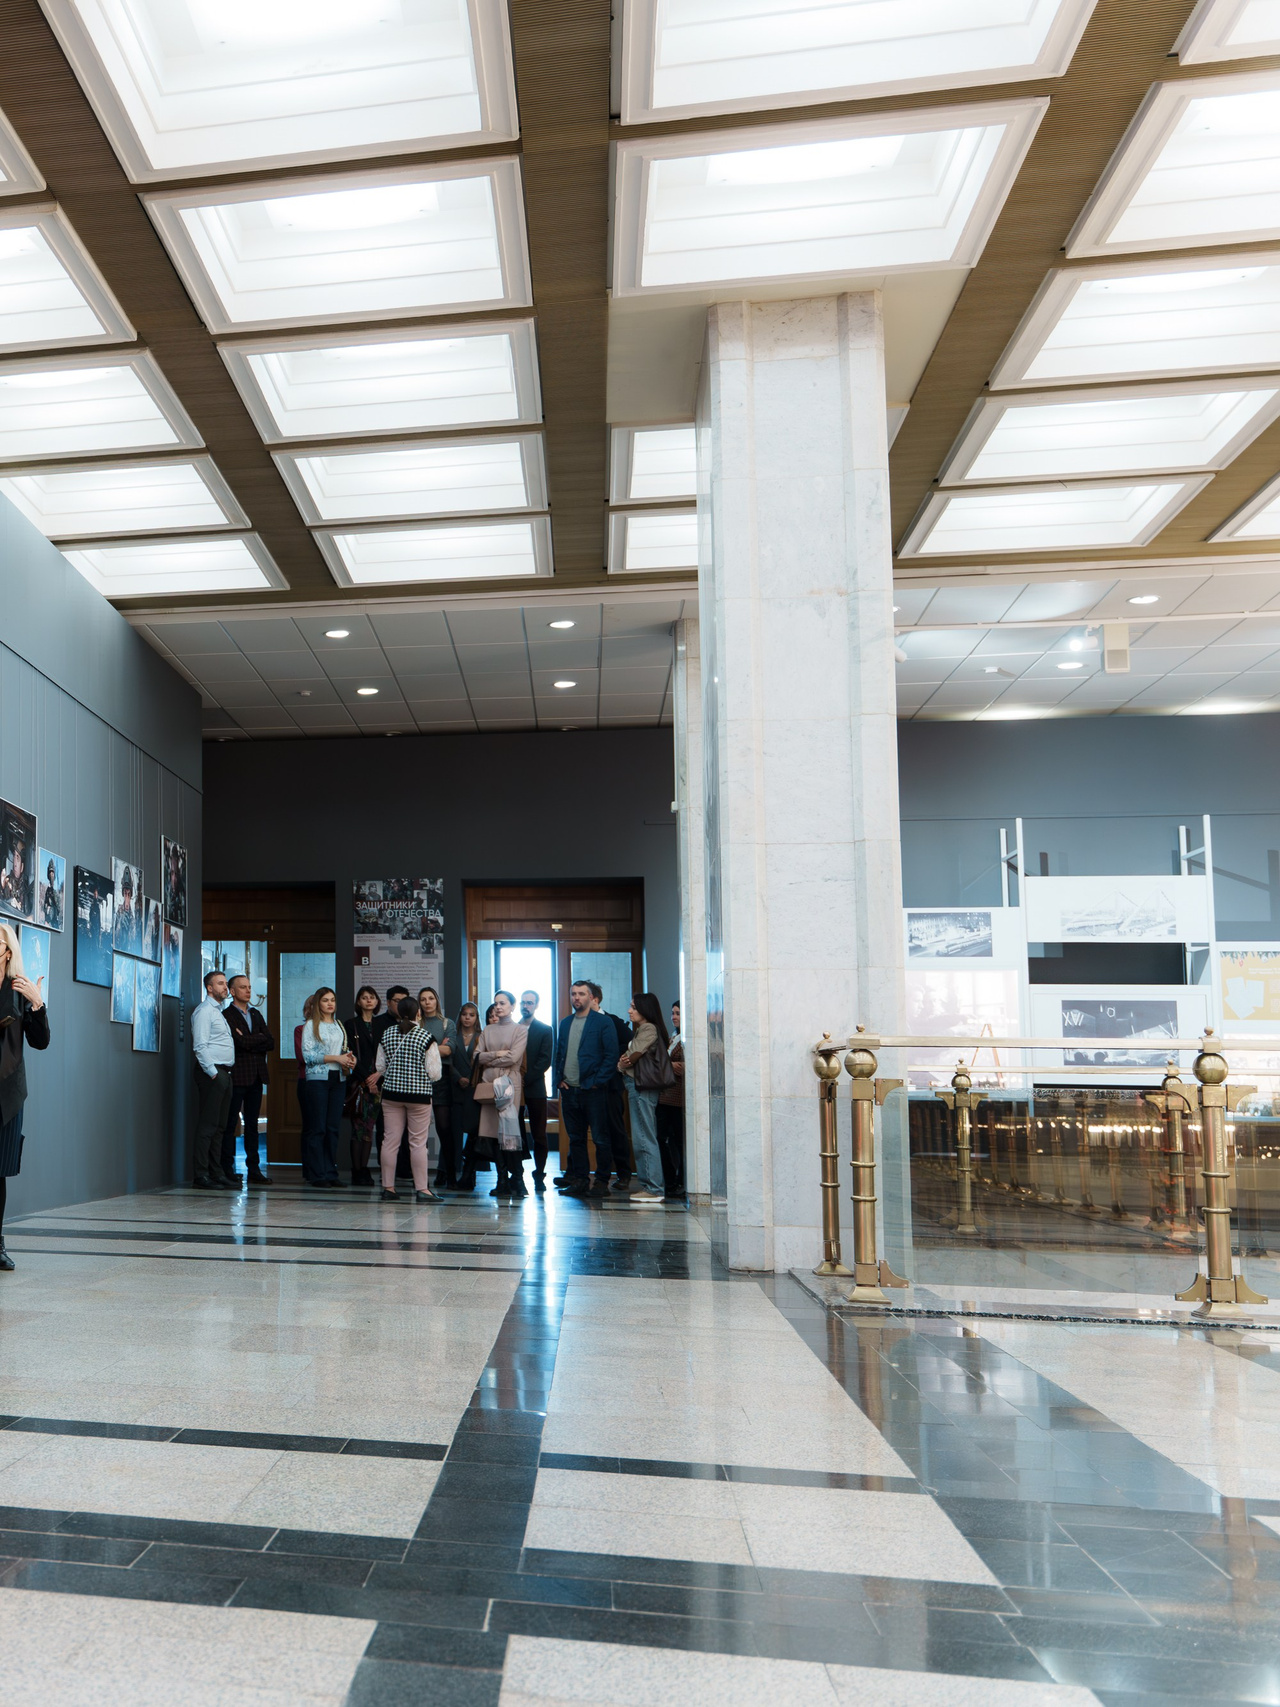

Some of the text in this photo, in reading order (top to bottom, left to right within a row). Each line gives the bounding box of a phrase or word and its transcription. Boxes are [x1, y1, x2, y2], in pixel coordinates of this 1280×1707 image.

[355, 901, 416, 910] ЗАЩИТНИКИ
[385, 909, 442, 918] ОТЕЧЕСТВА
[361, 956, 369, 965] В
